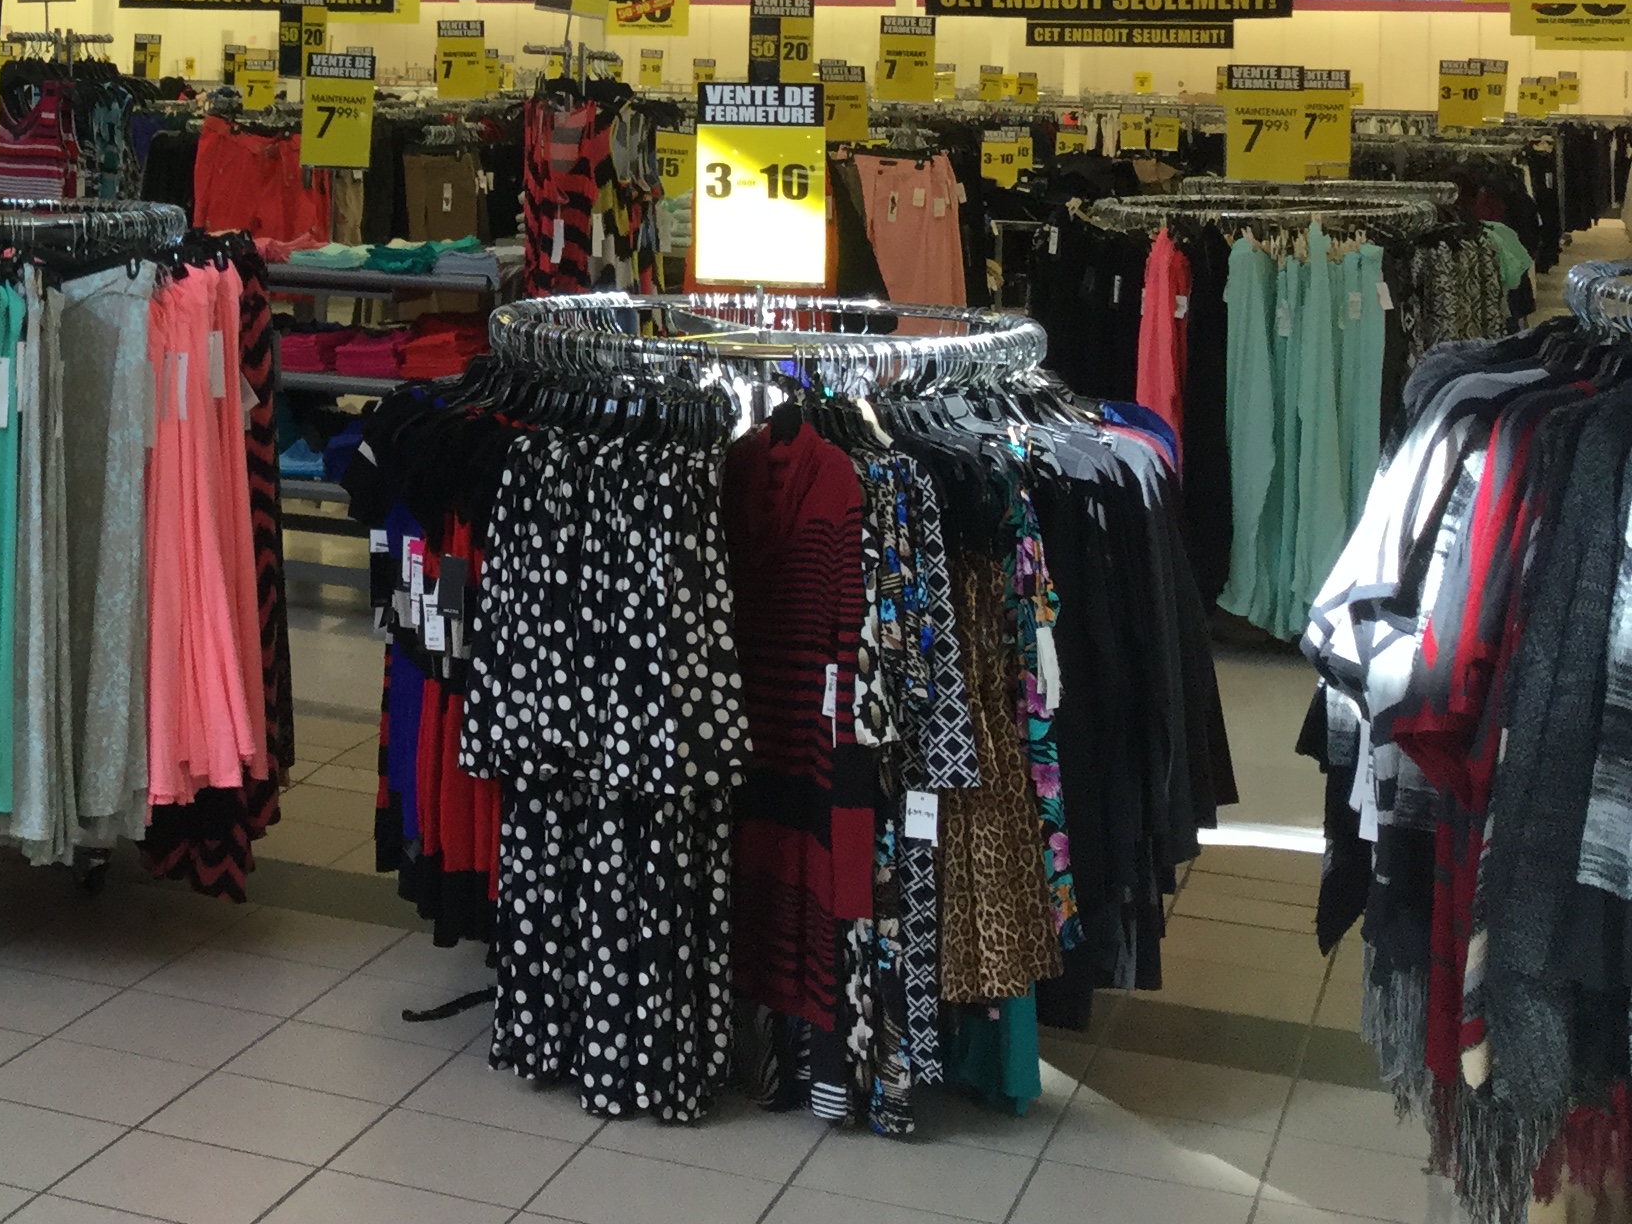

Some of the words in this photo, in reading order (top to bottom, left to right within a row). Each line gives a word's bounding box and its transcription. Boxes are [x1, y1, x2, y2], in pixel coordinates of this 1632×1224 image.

[754, 6, 810, 16] FERMETURE
[884, 17, 915, 27] VENTE
[918, 17, 932, 27] DE
[1034, 27, 1060, 42] CET
[1064, 28, 1128, 43] ENDROIT
[1133, 28, 1225, 44] SEULEMENT!
[312, 55, 351, 70] VENTE
[355, 56, 372, 69] DE
[311, 67, 371, 79] FERMETURE
[1232, 66, 1278, 79] VENTE
[1281, 66, 1300, 79] DE
[1232, 78, 1300, 90] FERMETURE
[311, 94, 366, 105] MAINTENANT
[705, 85, 778, 106] VENTE
[785, 86, 815, 106] DE
[705, 105, 815, 124] FERMETURE
